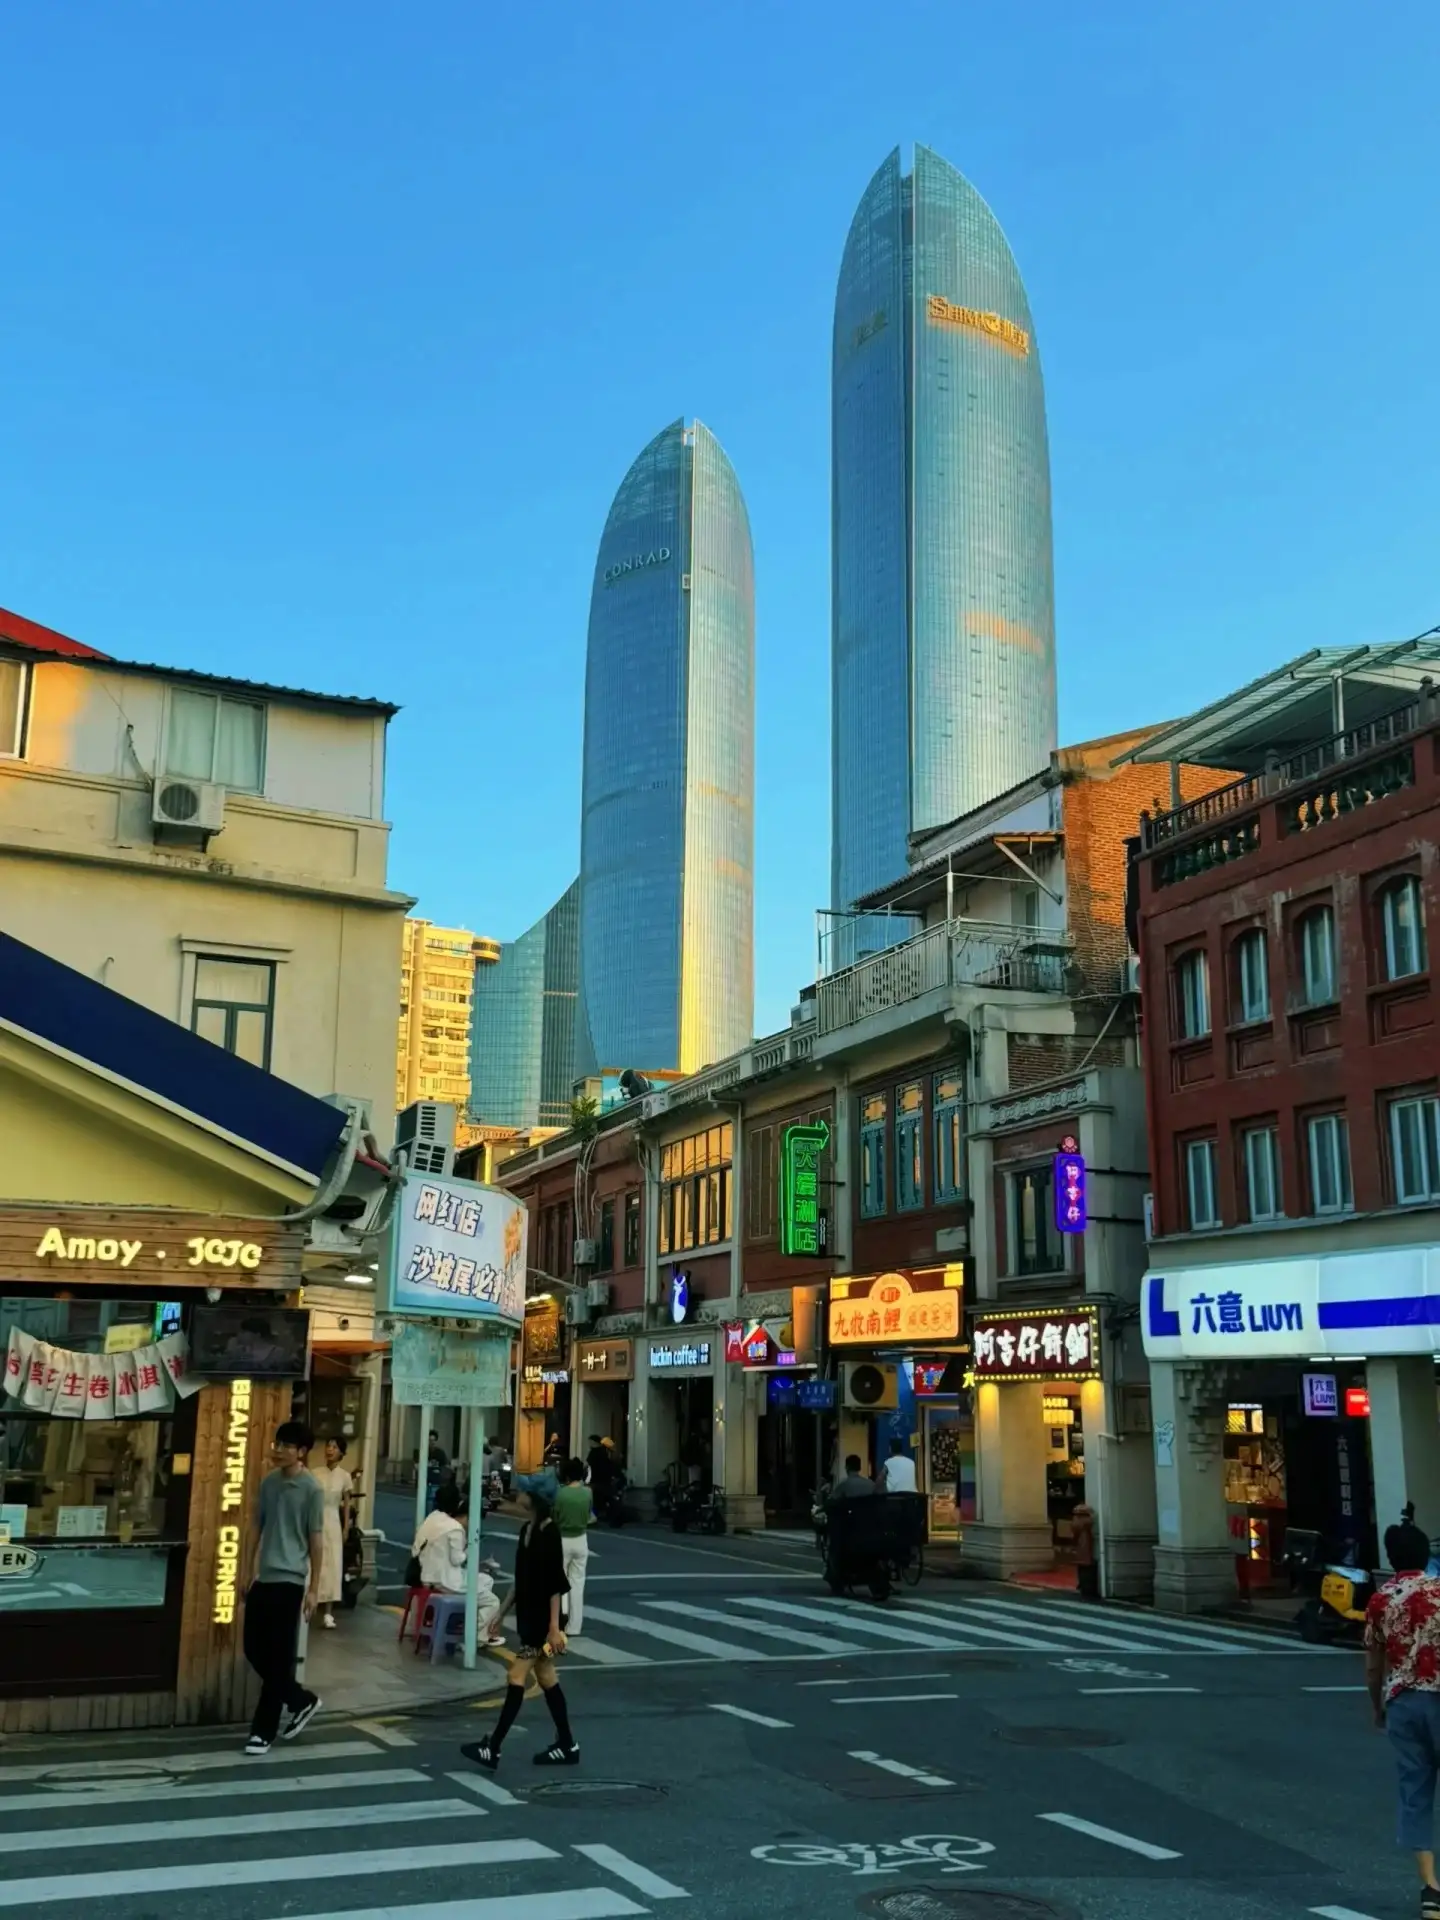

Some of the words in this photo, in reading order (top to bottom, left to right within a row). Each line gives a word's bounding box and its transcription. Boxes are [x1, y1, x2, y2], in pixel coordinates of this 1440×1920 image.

[604, 547, 670, 581] CONRAD
[414, 1184, 482, 1237] 网红店
[36, 1227, 142, 1267] Amoy
[1190, 1290, 1246, 1334] 六意
[1248, 1303, 1303, 1332] LIUYI
[650, 1345, 672, 1367] luckin
[673, 1344, 698, 1366] coffee
[221, 1379, 251, 1511] BEAUTIFUL
[213, 1526, 239, 1624] CORNER
